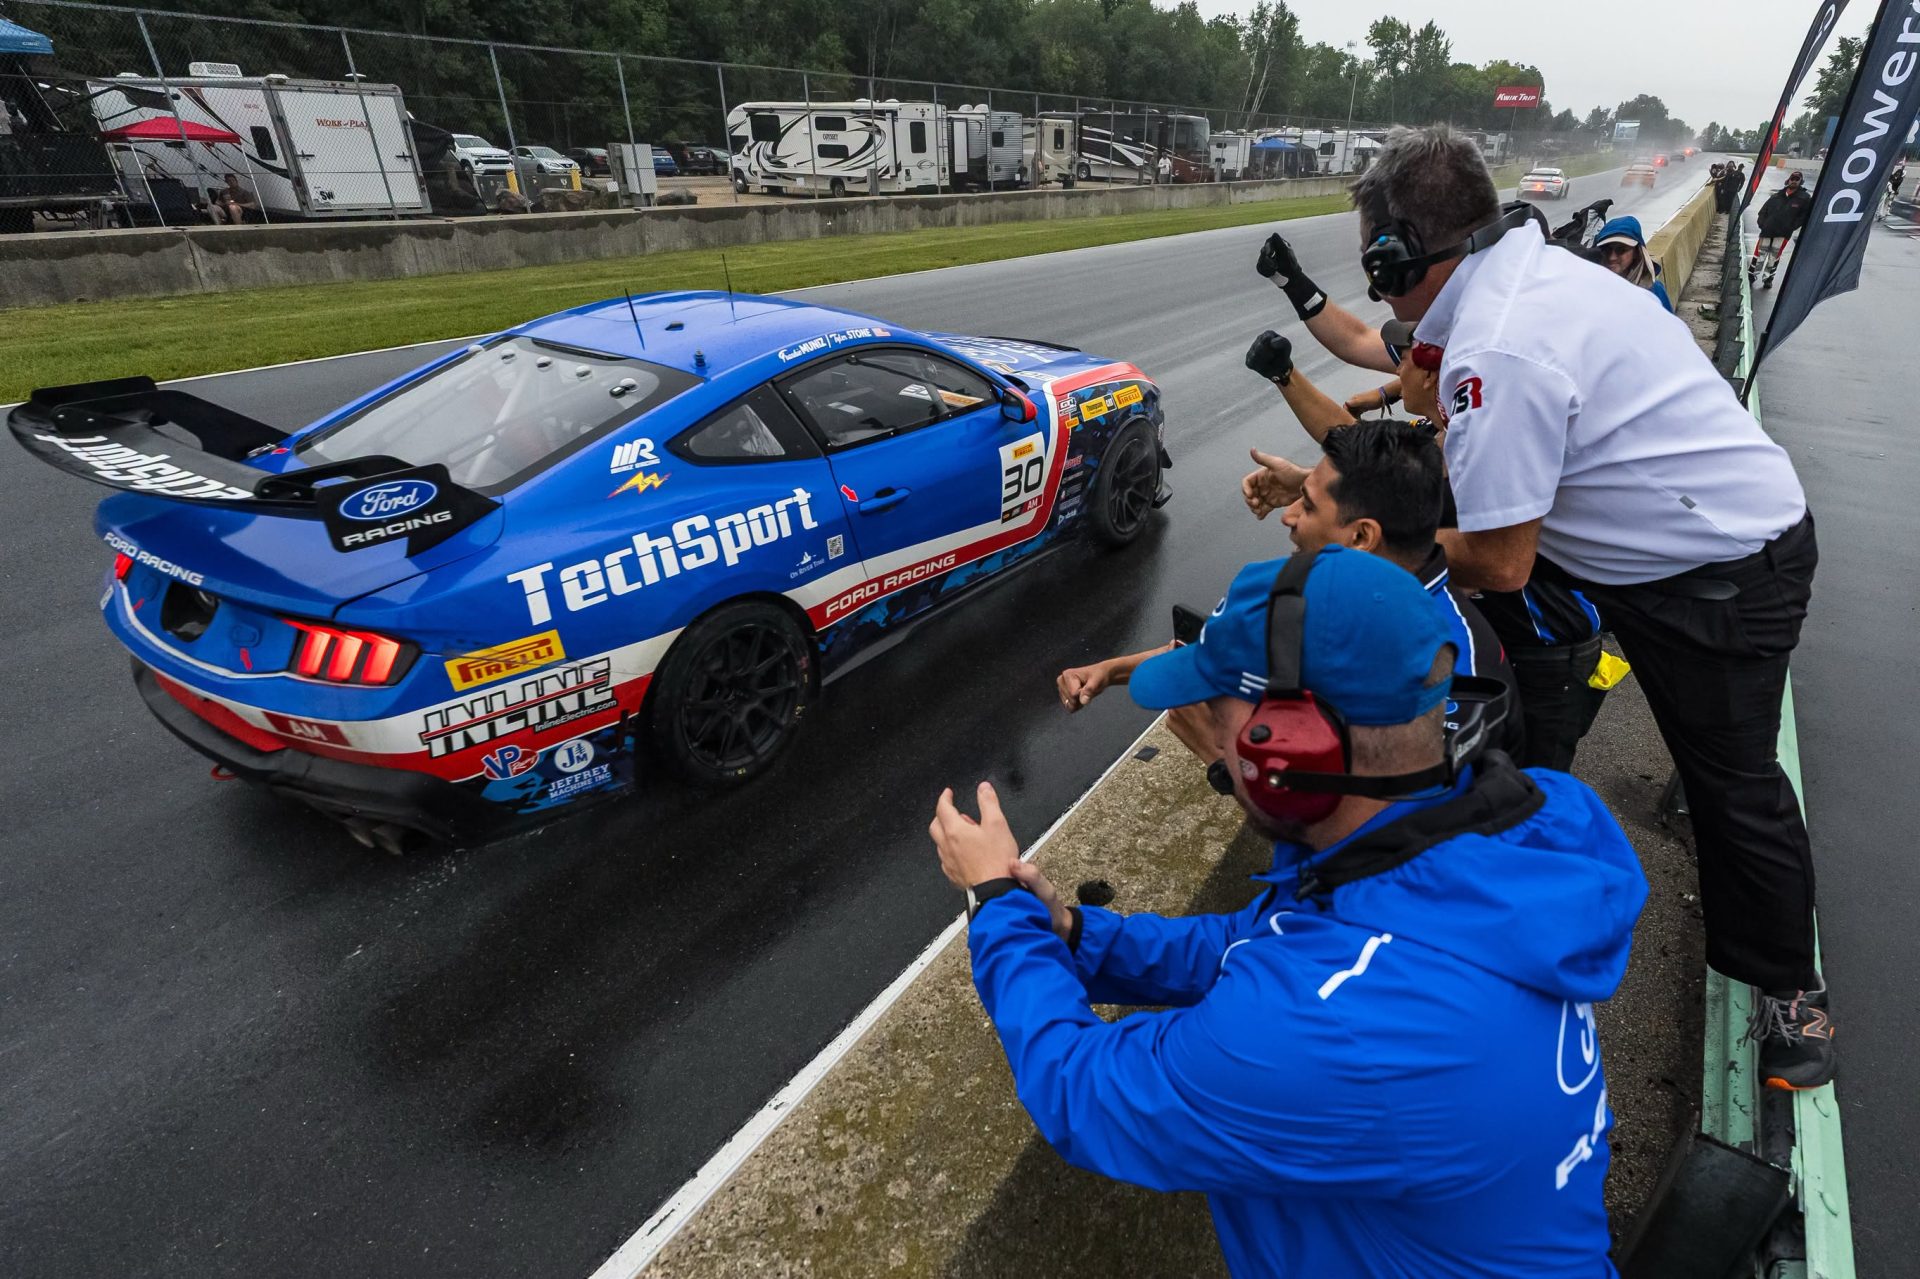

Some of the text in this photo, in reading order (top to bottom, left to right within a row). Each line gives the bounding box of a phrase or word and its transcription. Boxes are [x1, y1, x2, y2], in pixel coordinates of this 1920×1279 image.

[1496, 93, 1537, 101] KWIK TRIP
[1824, 0, 1920, 223] power
[316, 118, 342, 127] WORK
[800, 337, 828, 355] MUNIZ
[846, 328, 872, 340] STONE
[1117, 387, 1140, 405] PIRELLI
[1003, 456, 1044, 505] 30
[361, 486, 420, 516] Ford
[1027, 498, 1039, 510] AM
[342, 510, 453, 547] RACING
[103, 532, 205, 587] FORD RACING
[506, 488, 818, 626] TechSport
[826, 553, 957, 619] FORD RACING
[457, 637, 555, 684] PIRELLI
[420, 656, 614, 759] INLINE
[534, 700, 617, 734] InlineElectric.com
[287, 719, 329, 741] AM
[482, 745, 522, 779] VP
[547, 764, 610, 792] JEFFREY
[549, 780, 593, 799] MACHINE
[594, 773, 612, 786] INC
